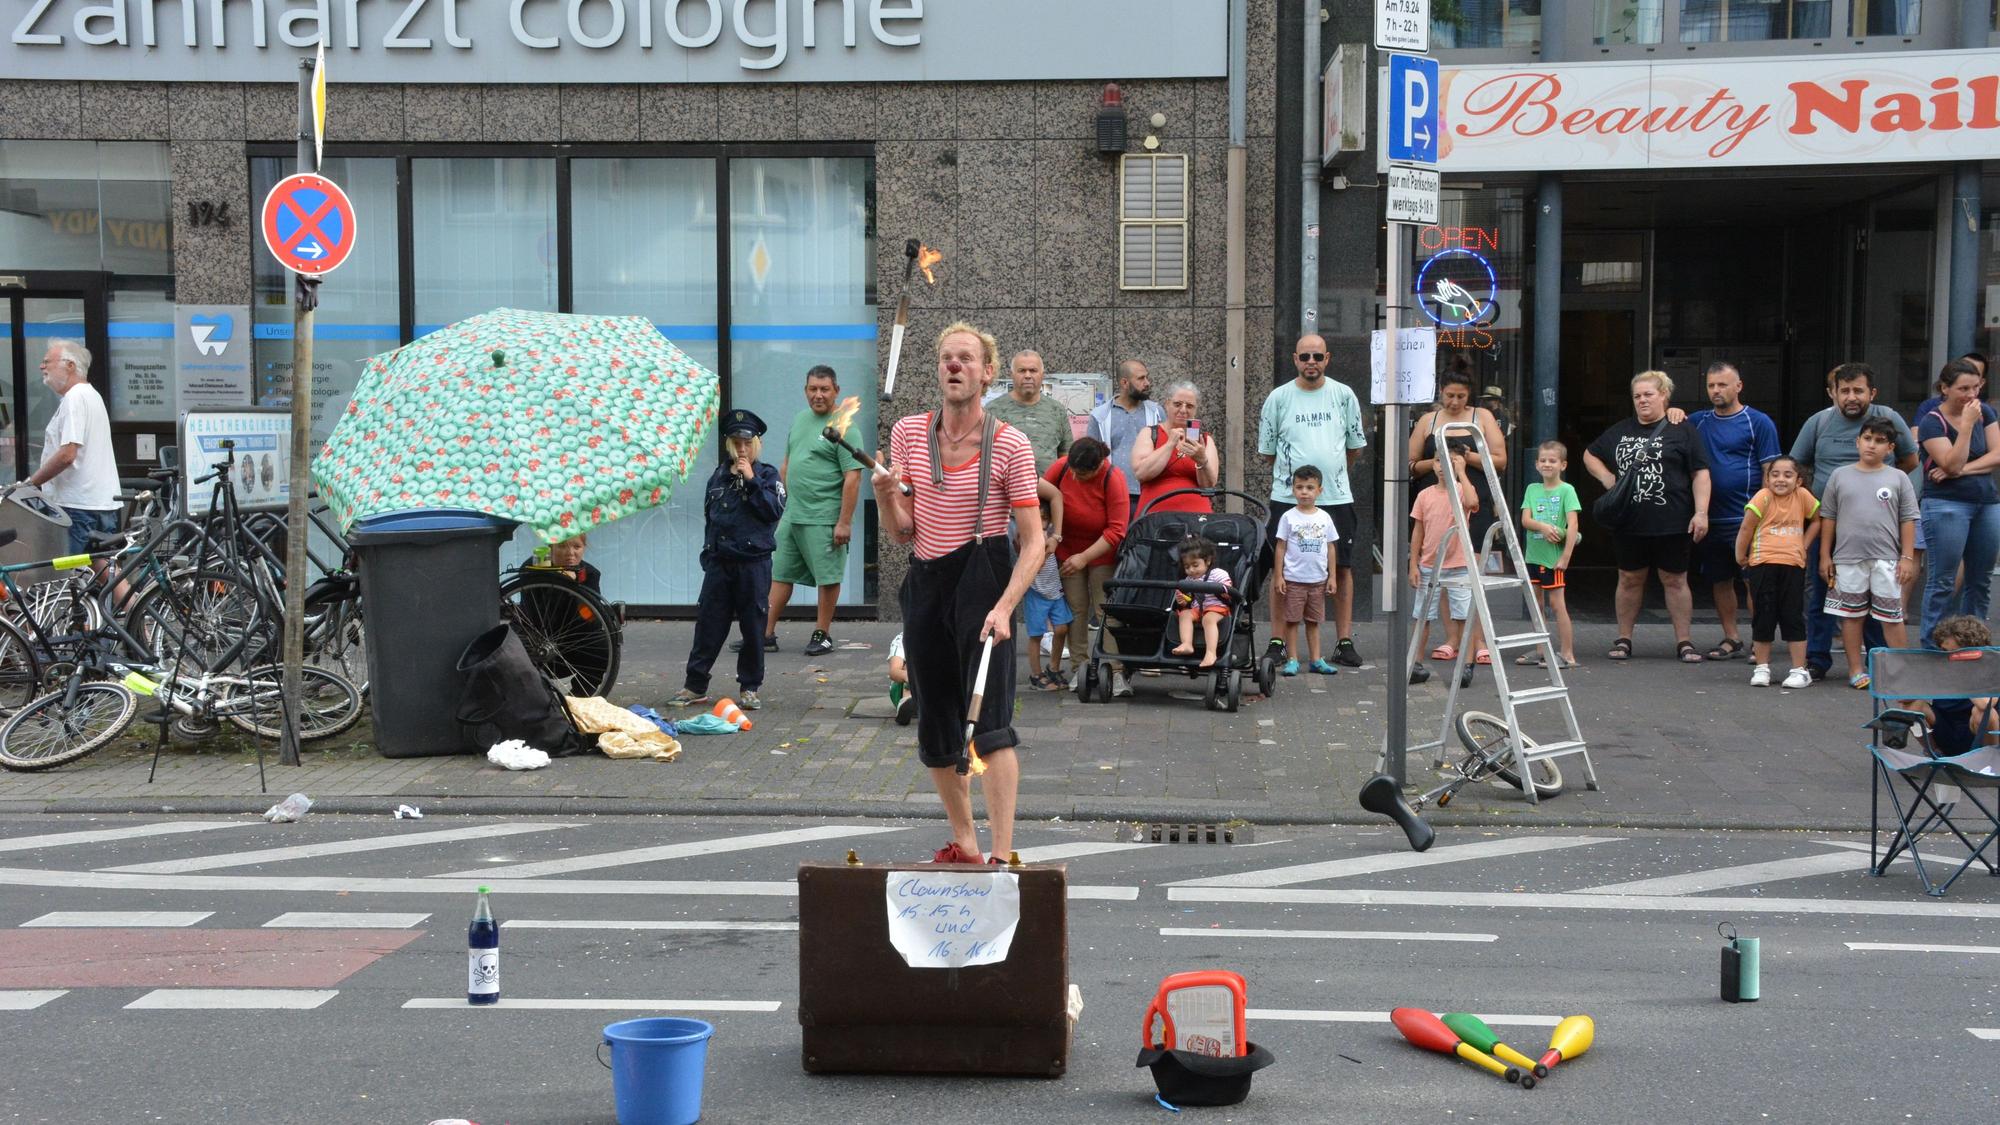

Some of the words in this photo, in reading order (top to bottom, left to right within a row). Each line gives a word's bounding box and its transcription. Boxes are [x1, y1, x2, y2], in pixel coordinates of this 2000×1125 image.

[1385, 0, 1398, 12] Am
[1399, 0, 1420, 14] 7.9.24
[1386, 18, 1391, 31] 7
[1392, 19, 1397, 31] h
[1403, 20, 1412, 32] 22
[1413, 21, 1418, 33] h
[1404, 69, 1429, 147] P
[1456, 73, 1771, 158] Beauty
[1410, 175, 1438, 192] Parkschein
[1392, 196, 1418, 216] werktags
[1420, 226, 1498, 250] OPEN
[1416, 320, 1494, 349] AILS
[1295, 412, 1332, 423] BALMAIN
[899, 879, 992, 897] Clownshow
[935, 919, 976, 934] und
